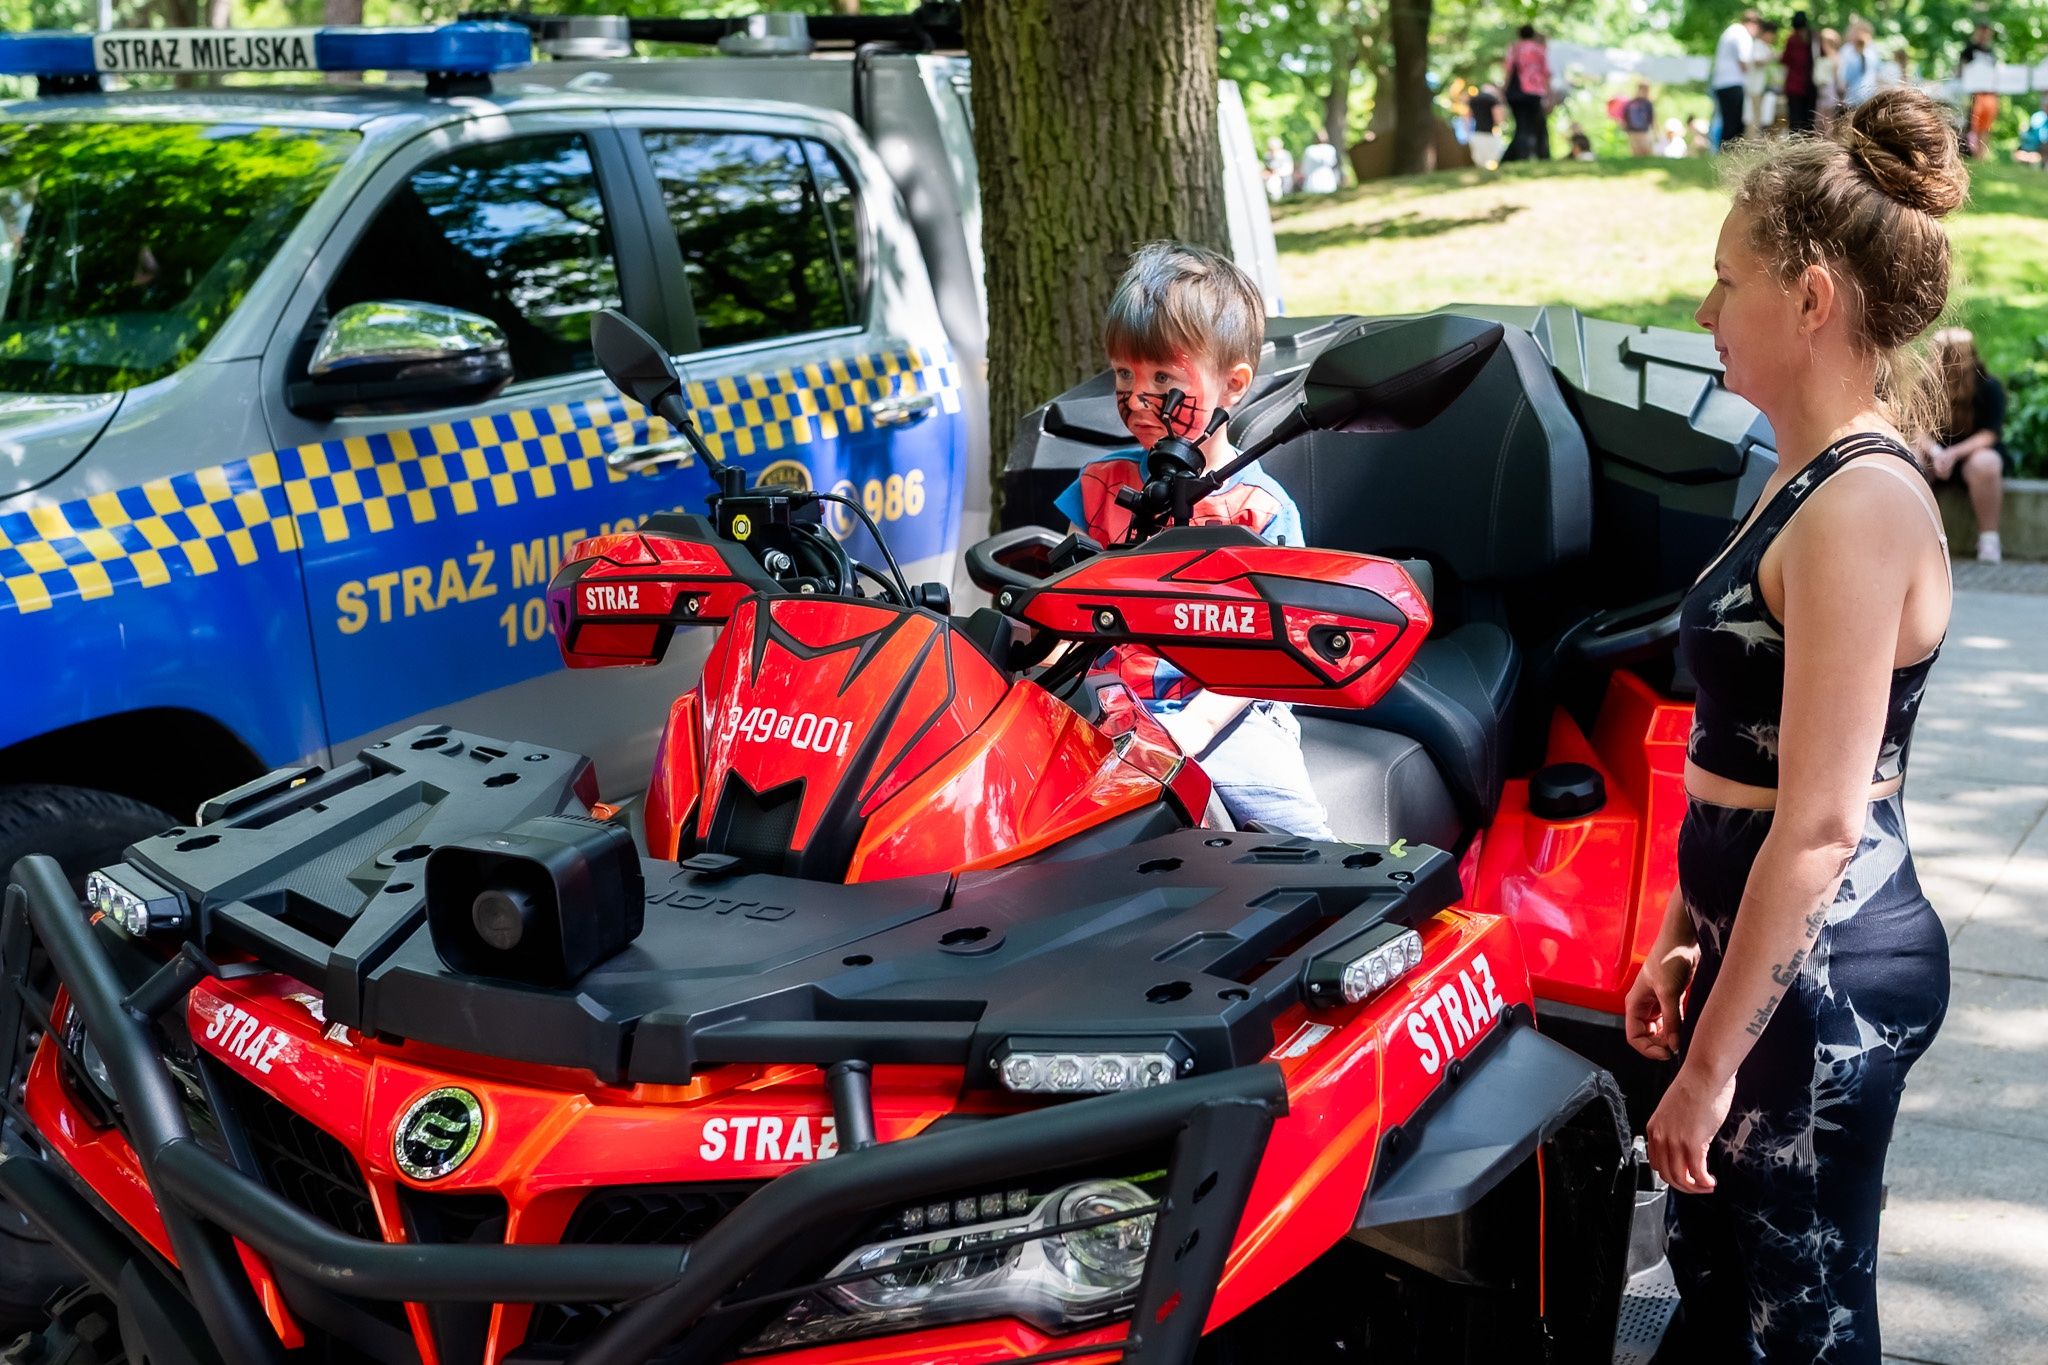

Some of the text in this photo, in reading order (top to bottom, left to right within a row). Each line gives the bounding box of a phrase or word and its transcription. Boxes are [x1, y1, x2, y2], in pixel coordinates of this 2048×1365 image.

[190, 37, 309, 68] MIEJSKA
[863, 468, 926, 525] 986
[335, 539, 498, 636] STRAŻ
[499, 596, 556, 648] 10
